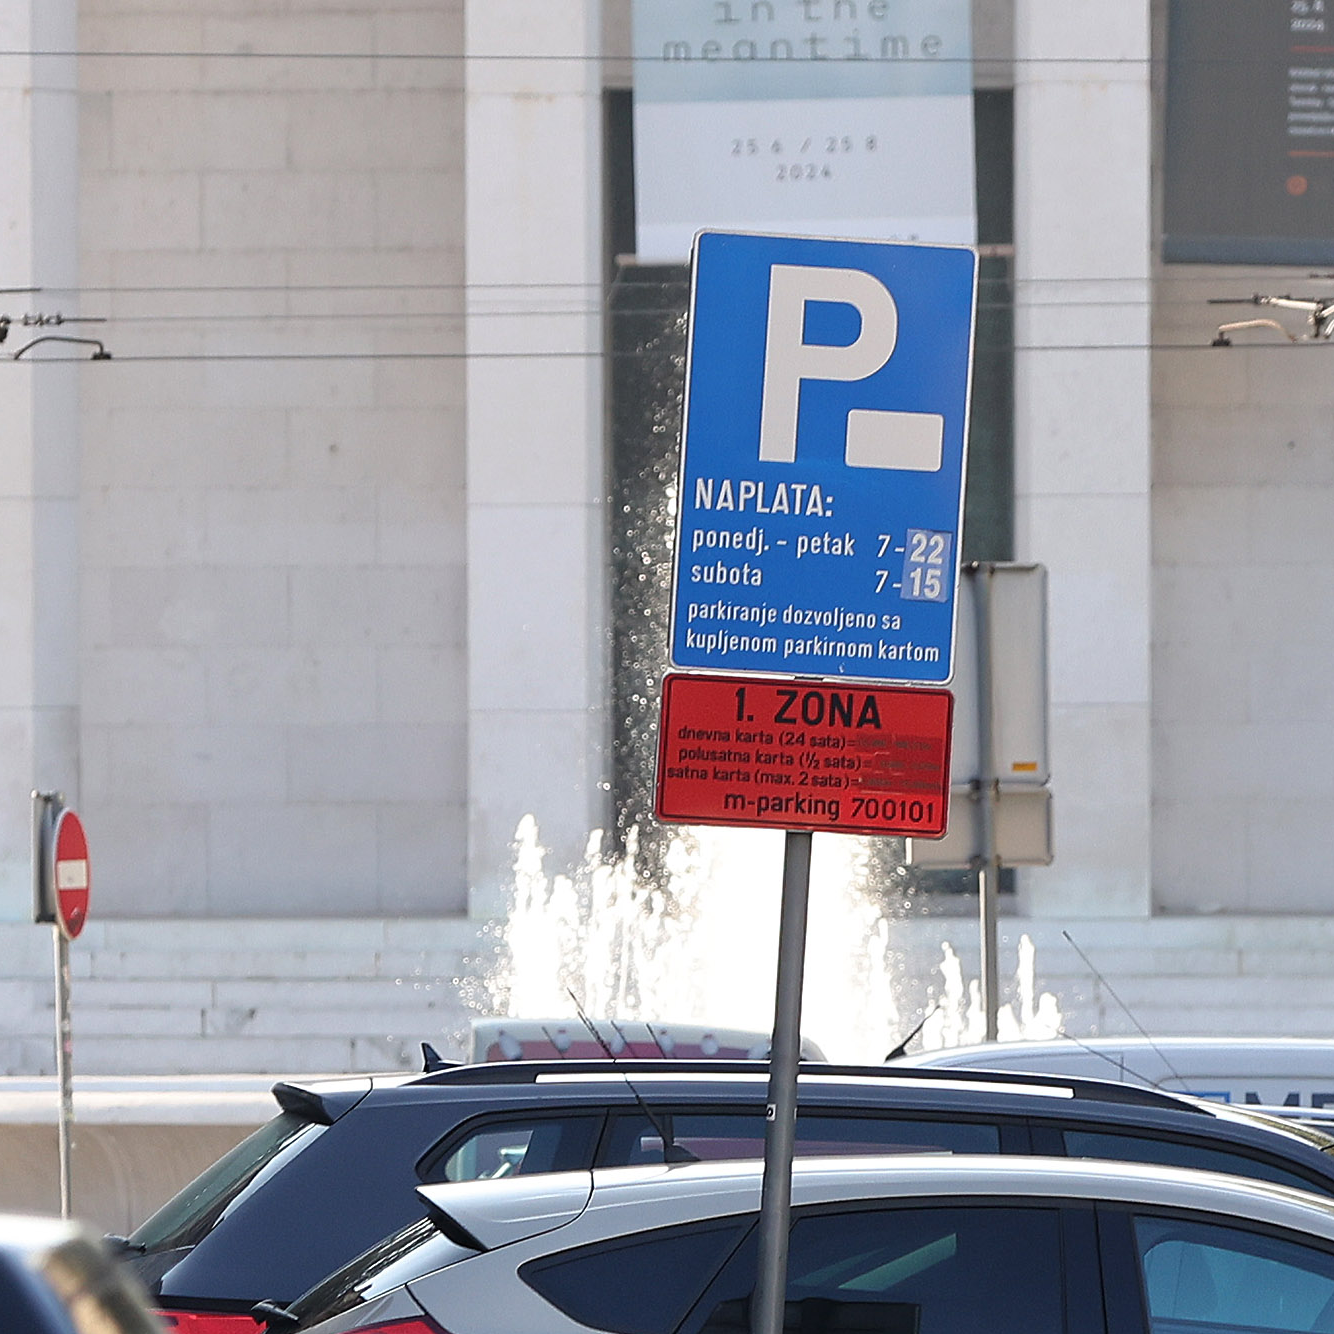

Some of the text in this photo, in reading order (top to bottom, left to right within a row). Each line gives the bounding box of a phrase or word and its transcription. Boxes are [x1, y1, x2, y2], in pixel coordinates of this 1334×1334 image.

[663, 28, 944, 61] meantime
[775, 164, 833, 182] 2024
[758, 264, 898, 463] P
[695, 478, 833, 517] NAPLATA:
[692, 527, 770, 556] ponedj.
[796, 533, 855, 559] petak
[690, 560, 762, 586] subota
[688, 600, 901, 632] parkiranje dozvoljeno sa
[686, 628, 939, 662] kupljenom parkirnom kartom
[735, 687, 882, 729] 1. ZONA
[678, 725, 730, 742] dnevna
[735, 728, 773, 745] karta
[778, 731, 806, 747] (24
[678, 746, 750, 763] polusatna
[755, 748, 794, 765] karta
[667, 766, 708, 780] satna
[713, 767, 750, 782] karta
[754, 769, 794, 786] (max.
[798, 771, 809, 786] 2
[724, 791, 934, 823] m-parking 700101
